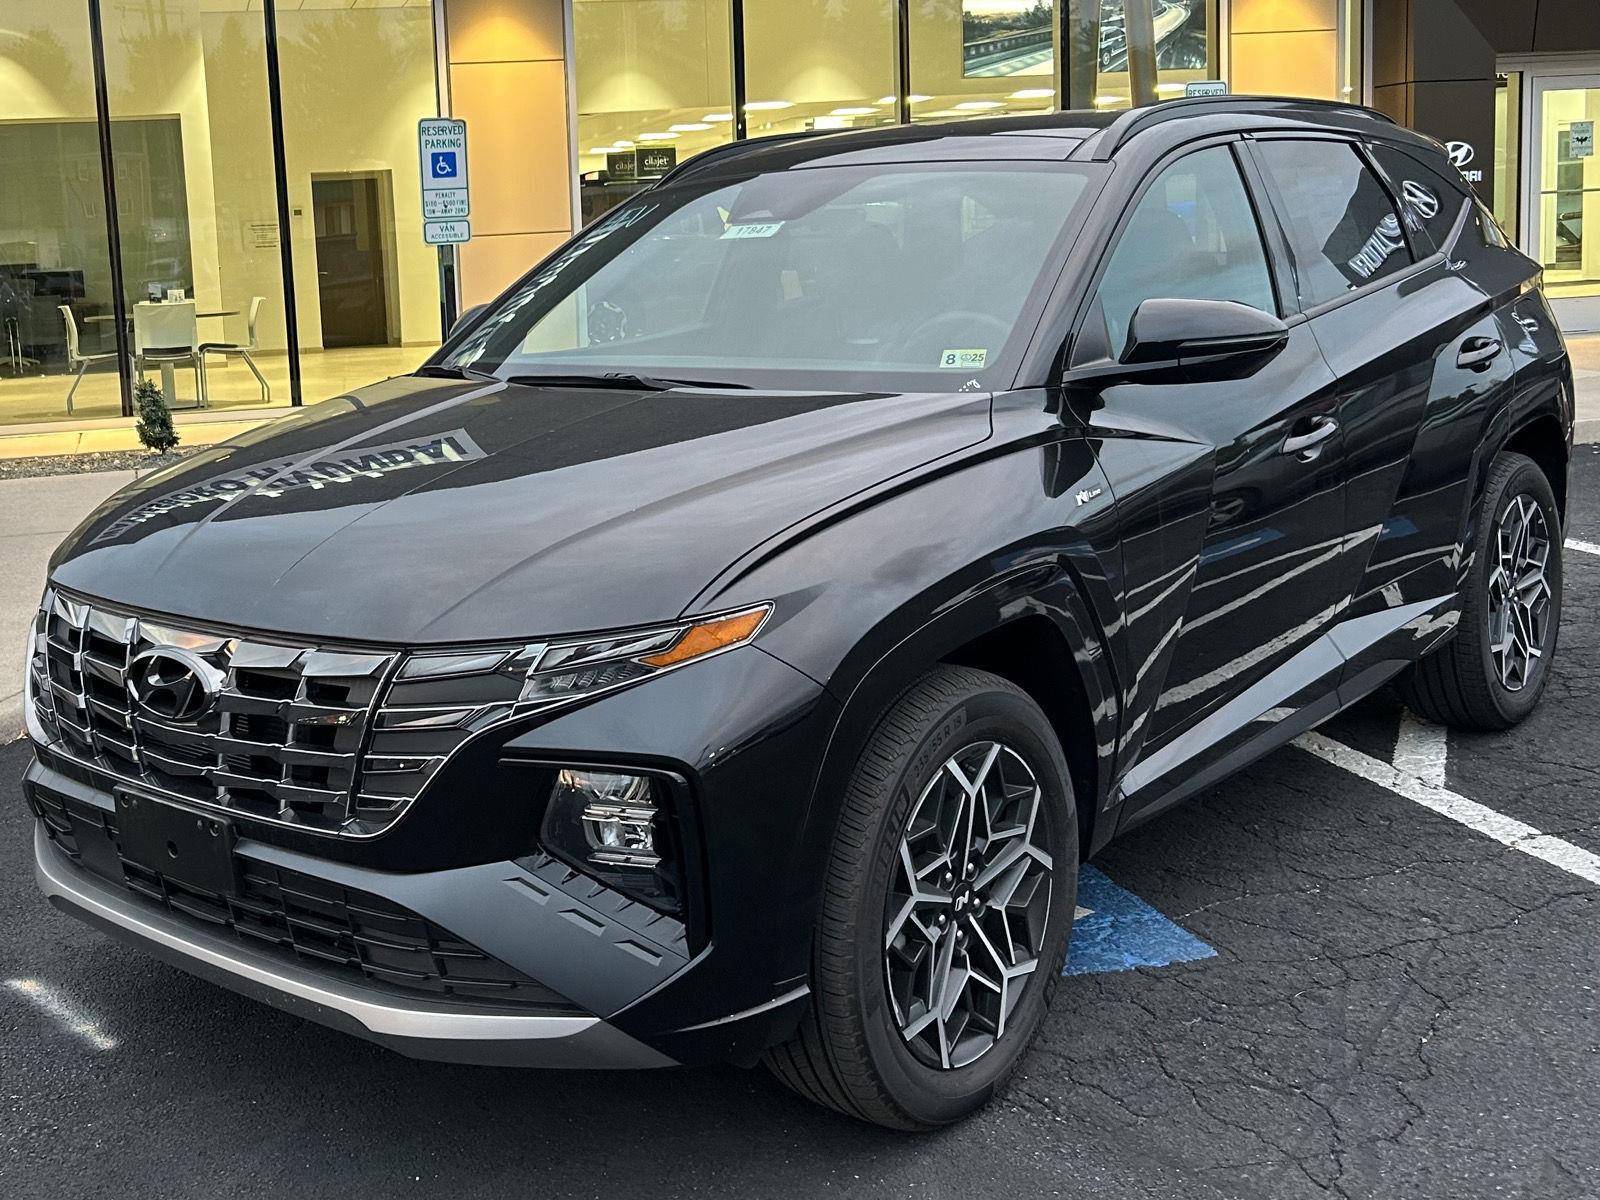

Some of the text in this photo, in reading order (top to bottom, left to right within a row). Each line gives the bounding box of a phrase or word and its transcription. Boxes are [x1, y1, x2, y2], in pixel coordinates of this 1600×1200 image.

[1189, 89, 1224, 97] RESERVED
[421, 125, 464, 136] RESERVED
[425, 138, 461, 149] PARKING
[737, 226, 772, 235] 17847
[945, 353, 956, 365] 8
[971, 353, 984, 362] 25
